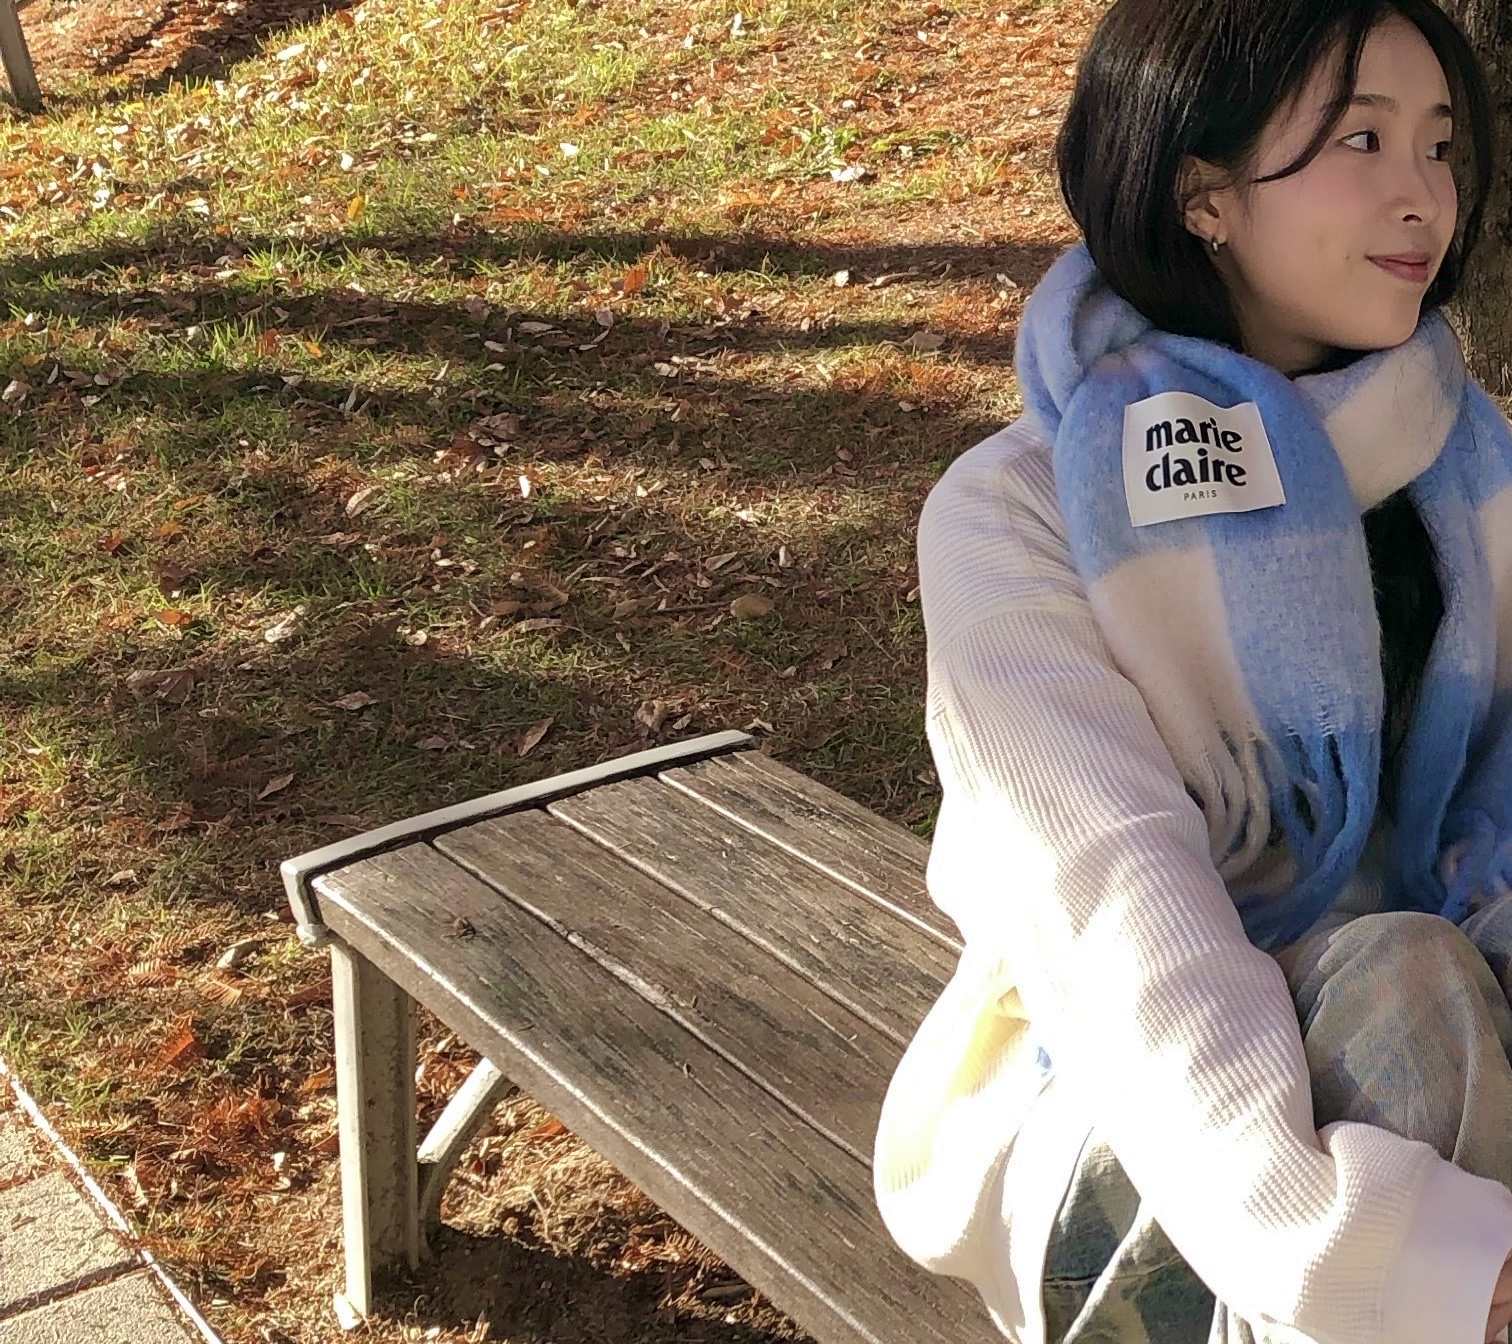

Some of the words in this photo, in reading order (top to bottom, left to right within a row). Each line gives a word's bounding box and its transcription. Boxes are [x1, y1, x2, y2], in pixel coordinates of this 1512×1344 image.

[1145, 416, 1243, 453] marie
[1145, 448, 1247, 492] claire
[1184, 490, 1217, 501] PARIS
